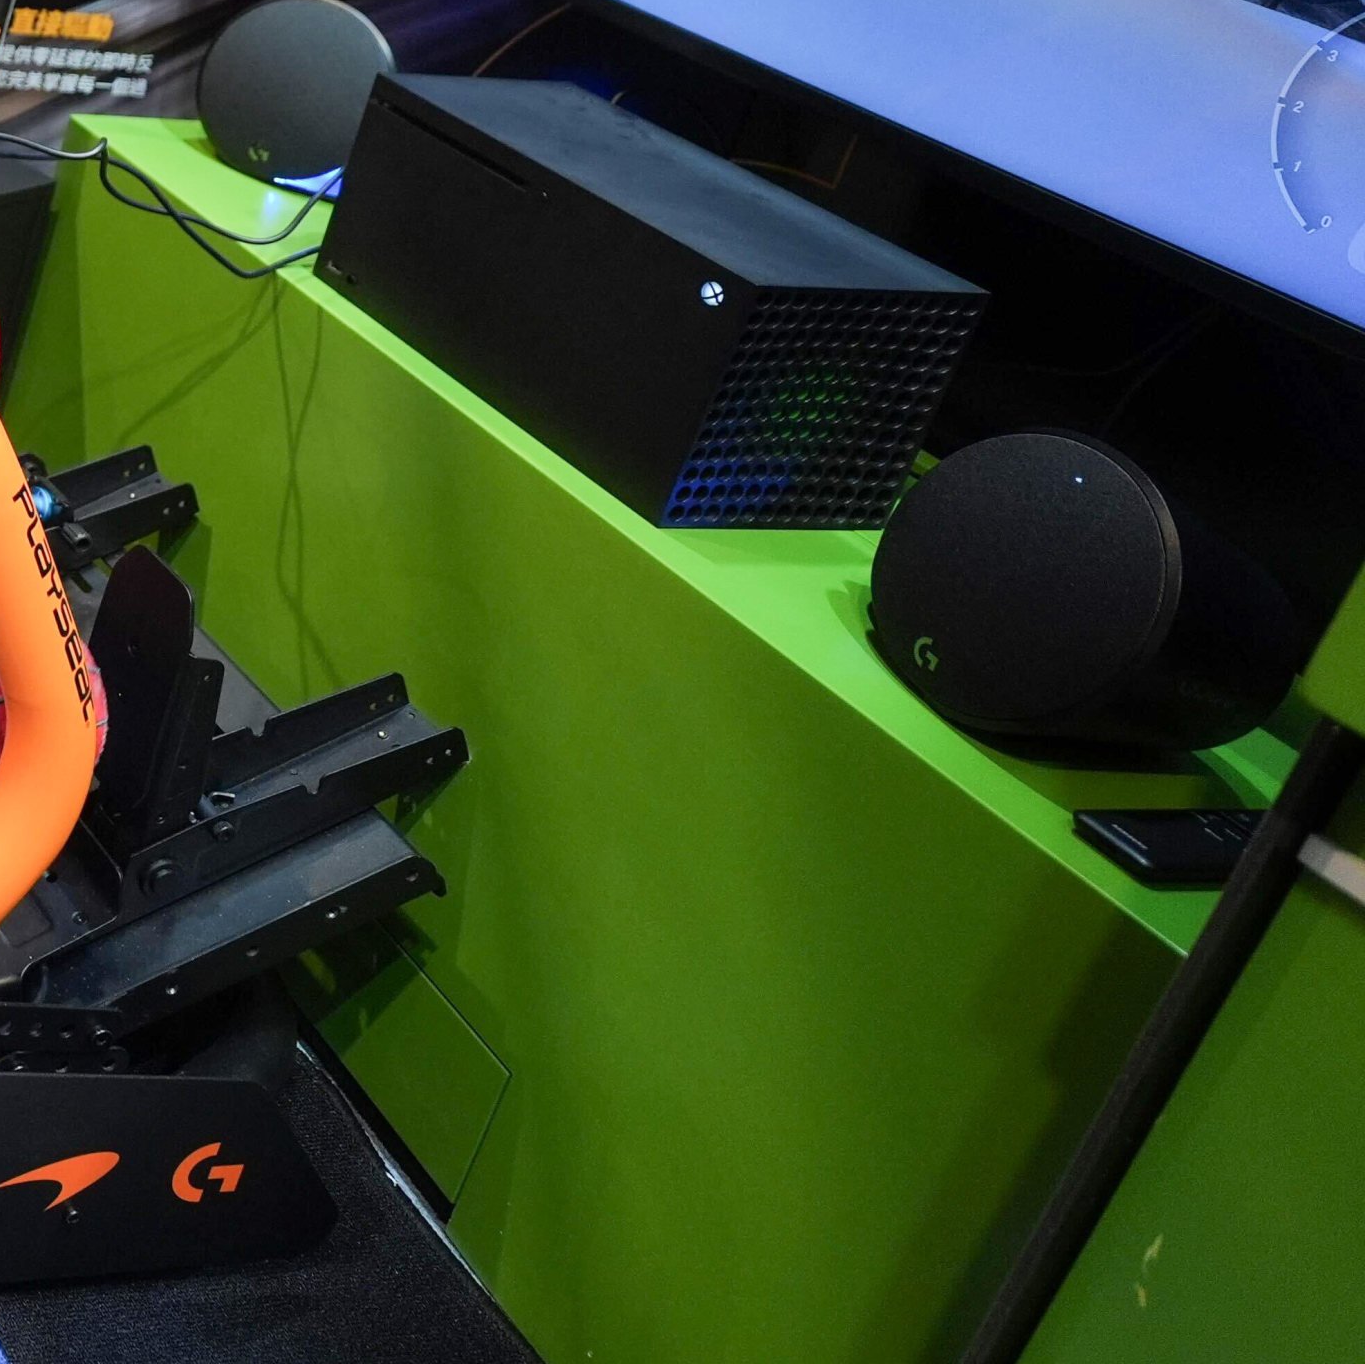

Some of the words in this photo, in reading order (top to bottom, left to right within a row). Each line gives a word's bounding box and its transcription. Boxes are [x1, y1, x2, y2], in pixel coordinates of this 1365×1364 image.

[1326, 49, 1340, 62] 3
[1293, 100, 1305, 113] 2
[1293, 160, 1302, 172] 1
[1320, 216, 1333, 228] 0
